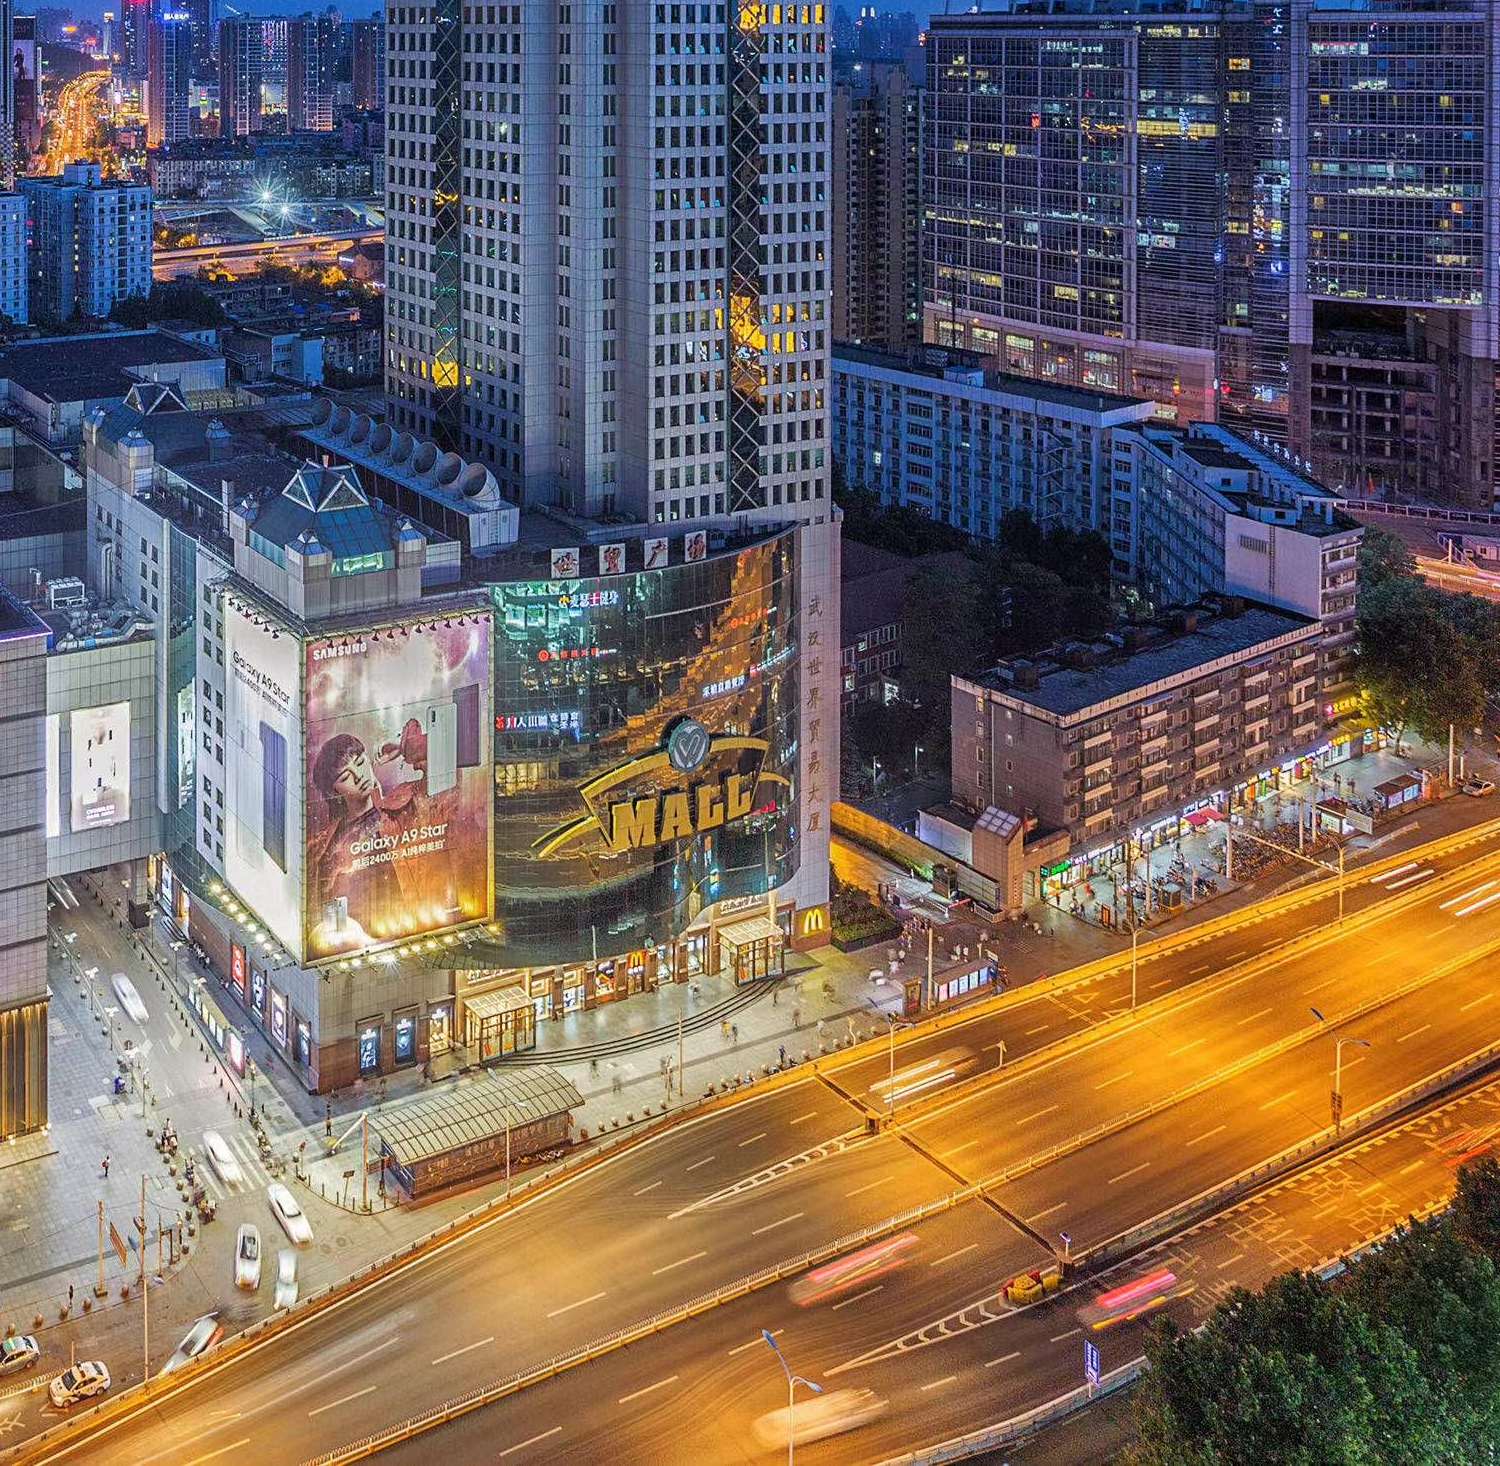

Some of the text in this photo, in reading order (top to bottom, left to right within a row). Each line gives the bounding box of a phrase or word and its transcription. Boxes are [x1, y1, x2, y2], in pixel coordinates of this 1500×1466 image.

[313, 641, 367, 661] SAMSUNG
[261, 674, 273, 690] A9
[273, 683, 290, 705] Star
[609, 774, 751, 852] MALL
[350, 822, 448, 855] Galaxy A9 Star
